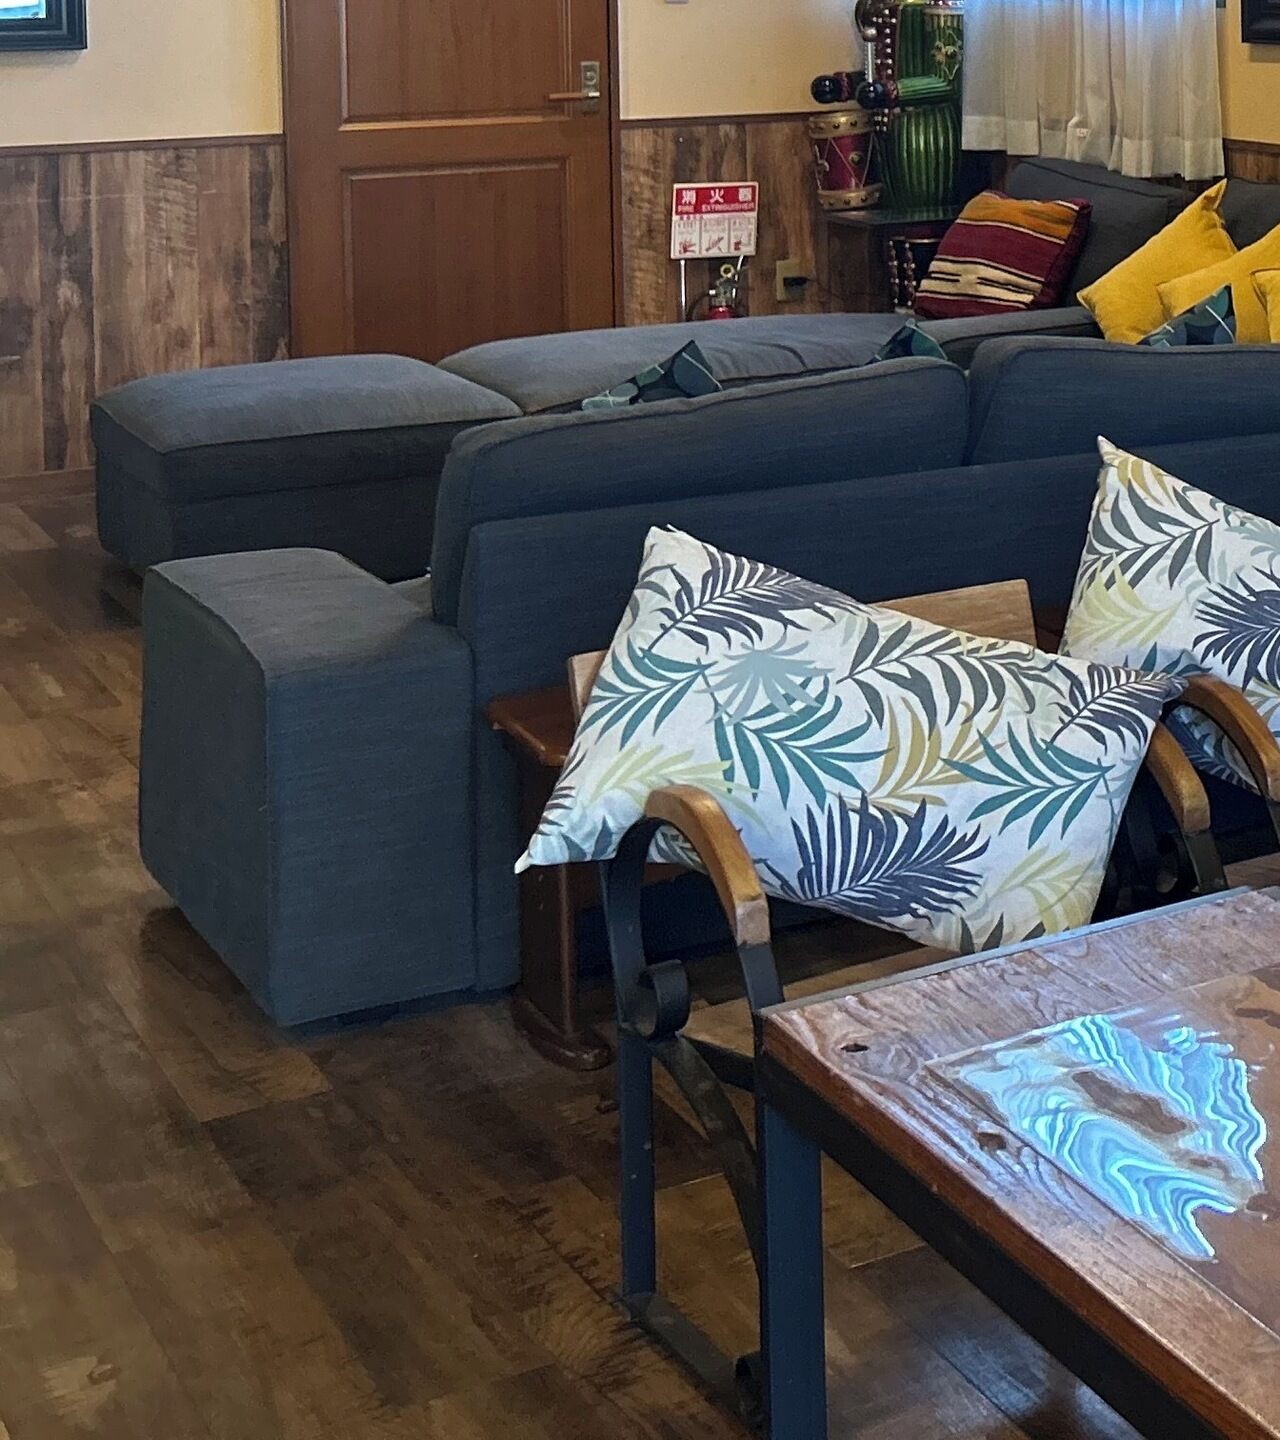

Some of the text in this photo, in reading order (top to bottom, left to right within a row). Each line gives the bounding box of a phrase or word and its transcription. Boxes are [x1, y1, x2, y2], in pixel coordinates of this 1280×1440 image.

[682, 187, 753, 205] 消火器
[701, 202, 755, 213] EXTINGUISHER
